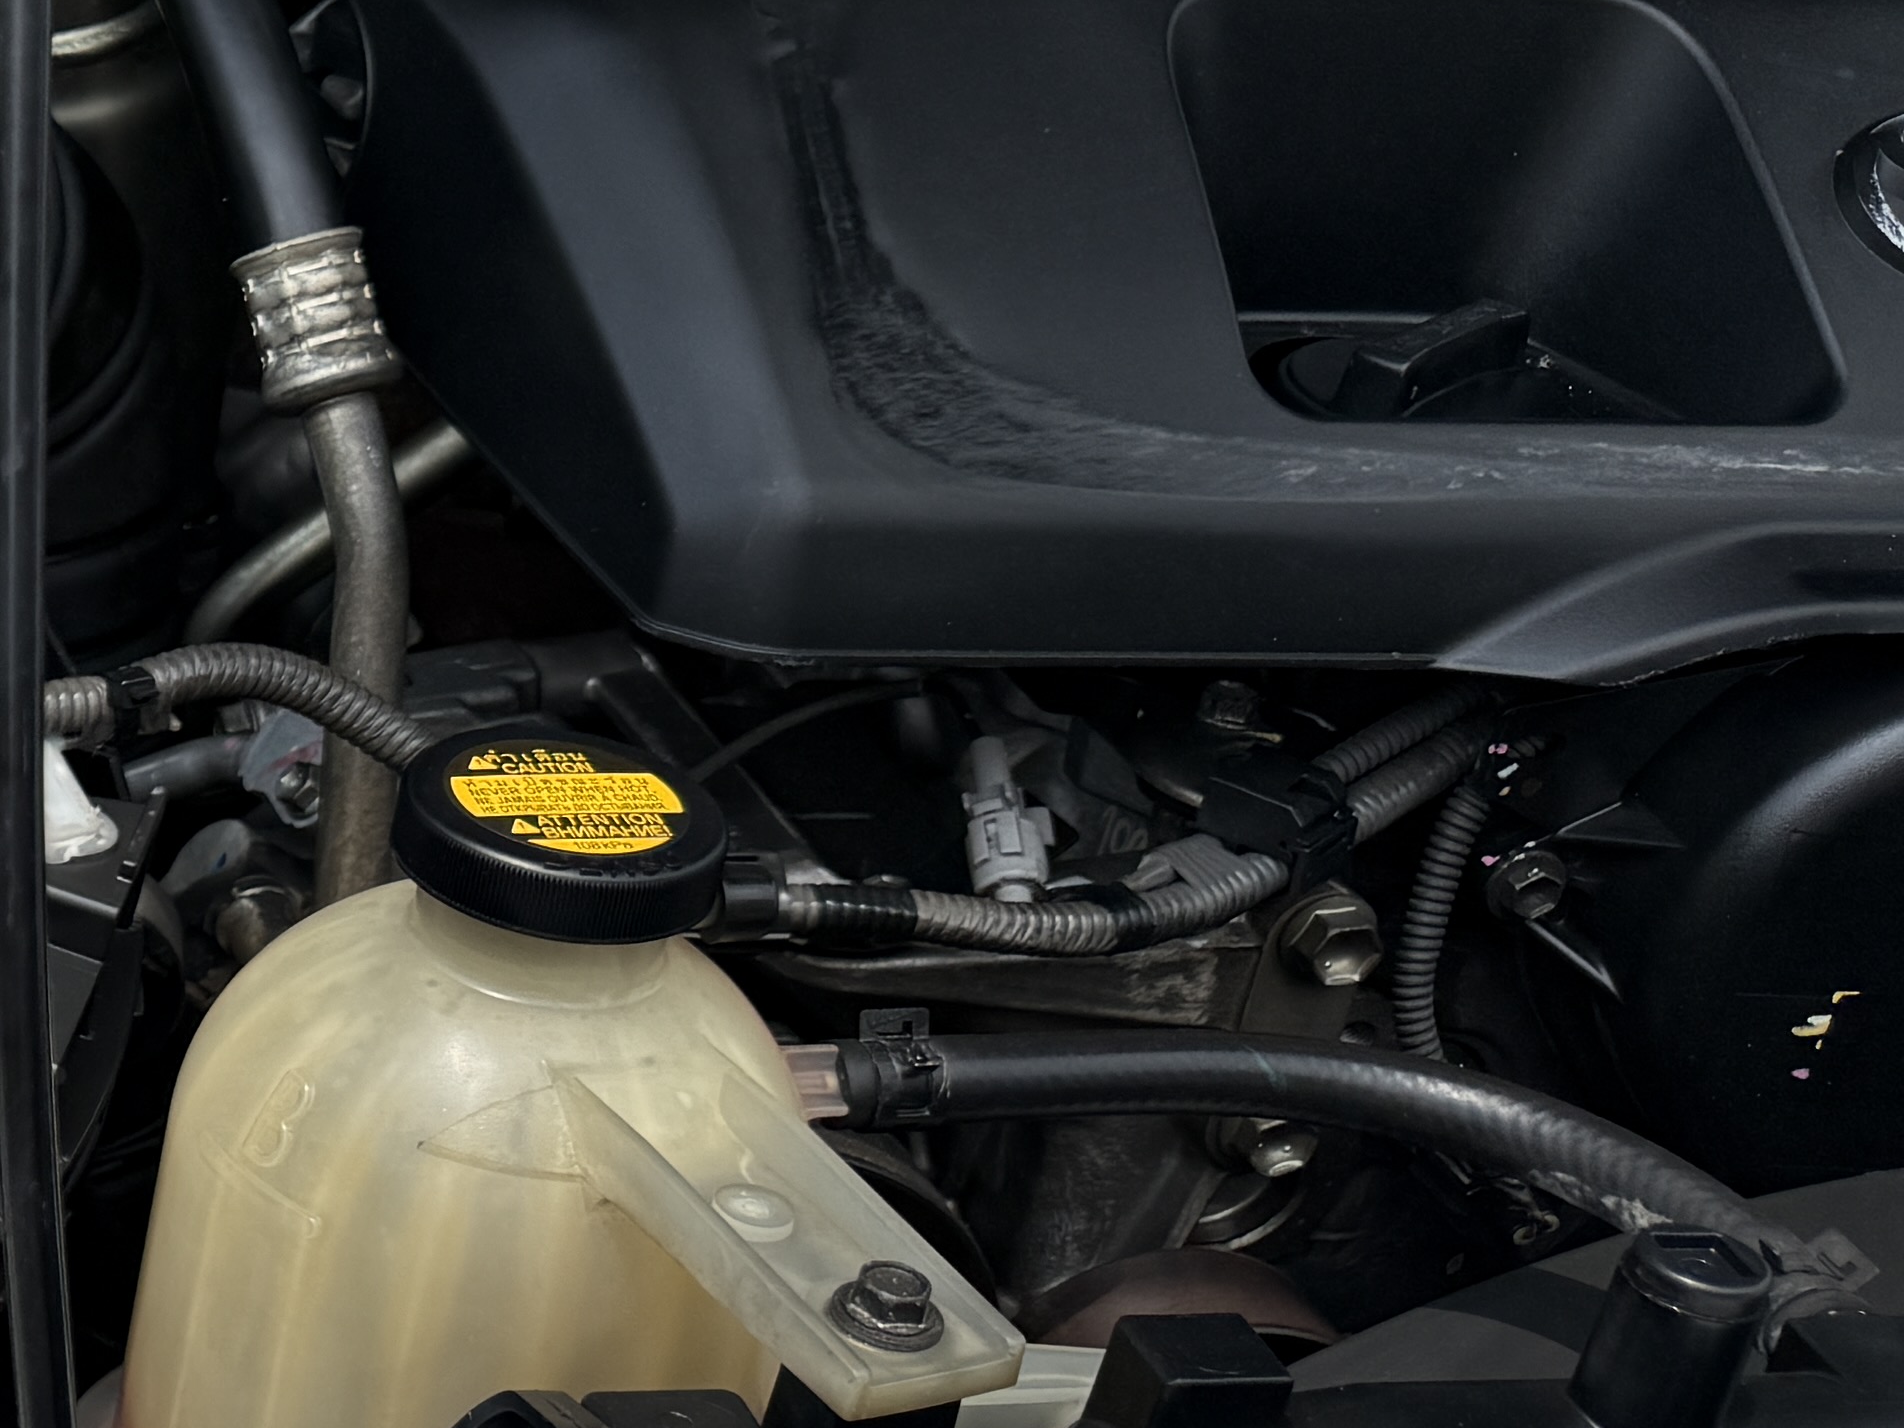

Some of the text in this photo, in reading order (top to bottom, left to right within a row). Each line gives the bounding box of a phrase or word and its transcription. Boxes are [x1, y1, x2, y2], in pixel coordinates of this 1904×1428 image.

[502, 762, 594, 773] CAUTION
[469, 787, 521, 797] NEVER
[524, 786, 567, 796] OPEN
[570, 785, 616, 794] WHEN
[474, 797, 494, 805] NE
[497, 795, 546, 804] JAMAIS
[548, 794, 599, 803] OUVRIR
[537, 814, 664, 826] ATTENTION
[541, 825, 674, 838] ВНИМАНИЕ!
